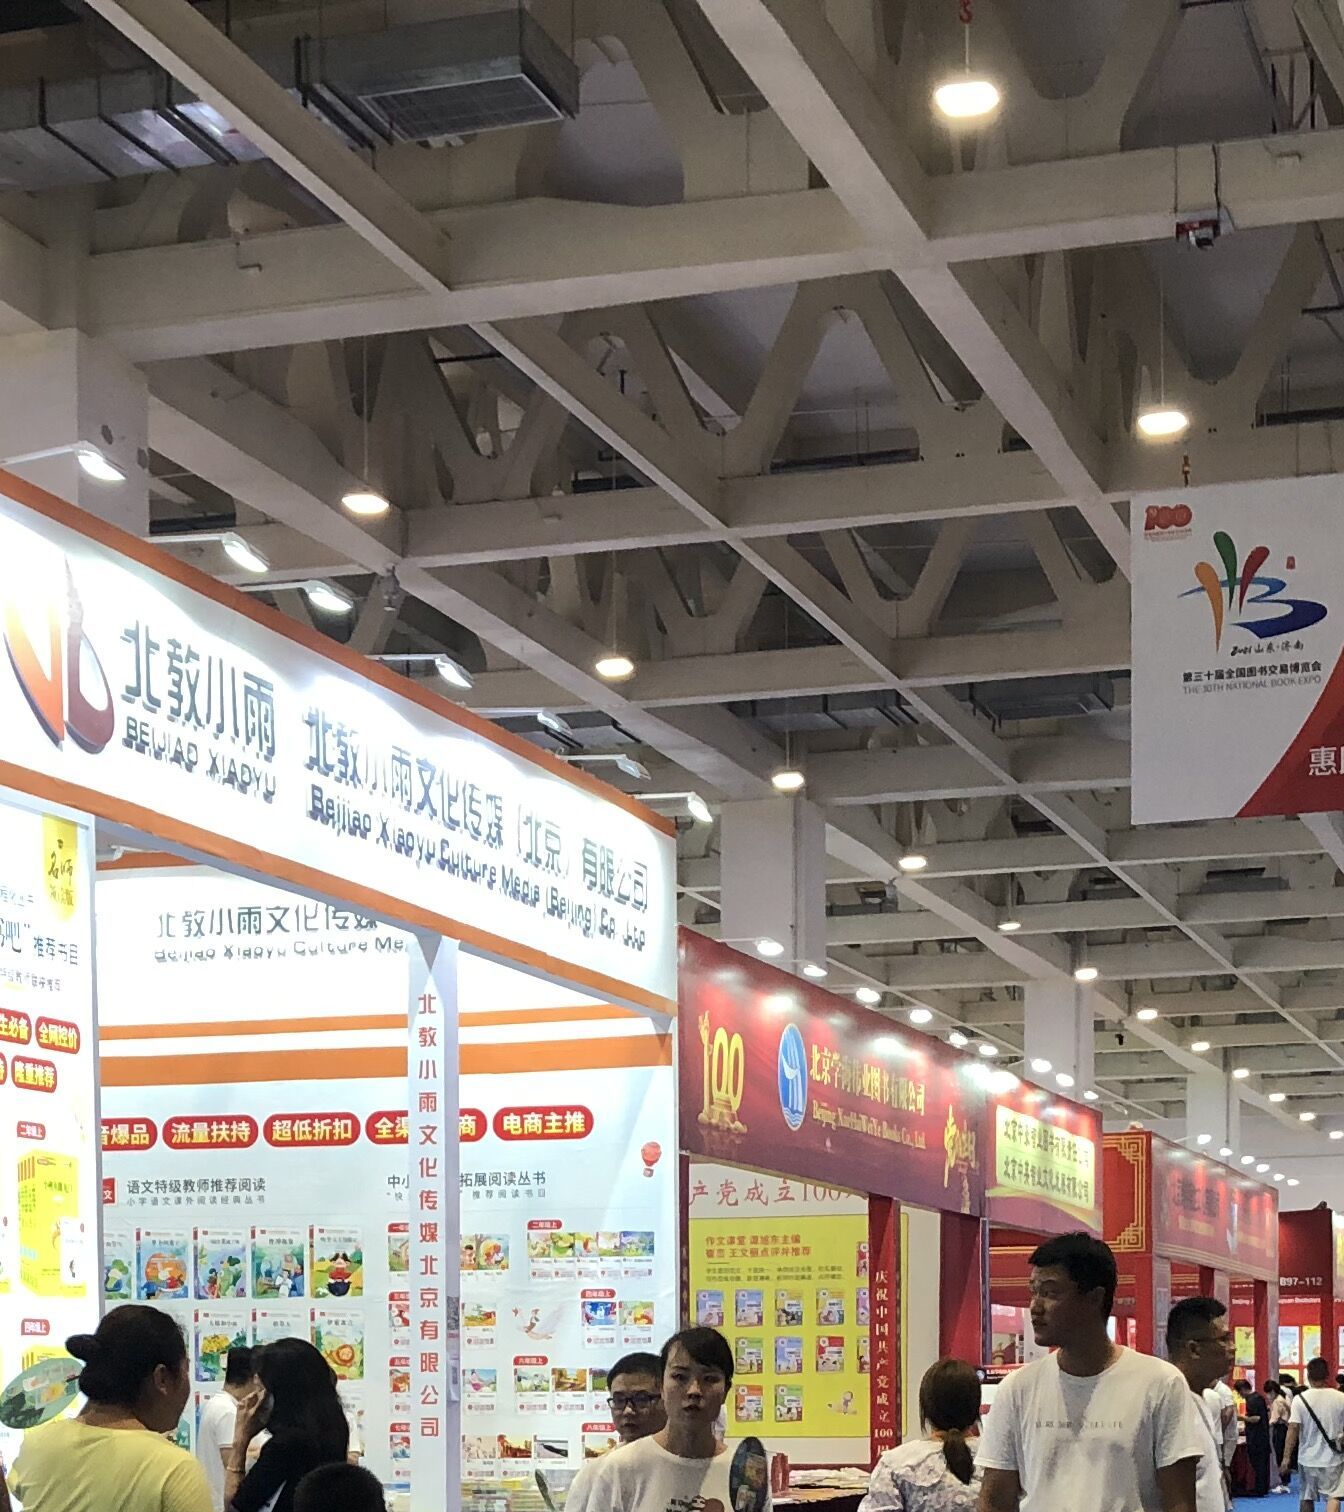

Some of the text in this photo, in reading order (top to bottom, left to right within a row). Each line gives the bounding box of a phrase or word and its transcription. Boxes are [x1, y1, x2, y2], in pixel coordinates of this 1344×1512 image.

[121, 620, 277, 762] 北教小雨
[1226, 679, 1268, 691] NATIONAL
[1271, 676, 1297, 688] BOOK
[1298, 673, 1322, 685] EXPO
[124, 715, 277, 800] BEIJIAO XIAOYU
[310, 784, 372, 839] Beijiao
[440, 838, 497, 885] Culture
[38, 1022, 80, 1050] 全网控价
[171, 1117, 252, 1144] 流量扶持
[271, 1115, 354, 1142] 超低折扣
[502, 1110, 586, 1135] 电商主推
[126, 1177, 267, 1196] 语文特级教师推荐阅读
[459, 1170, 546, 1188] 拓展阅读丛书
[417, 992, 441, 1438] 北教小雨文化传媒北京有限公司
